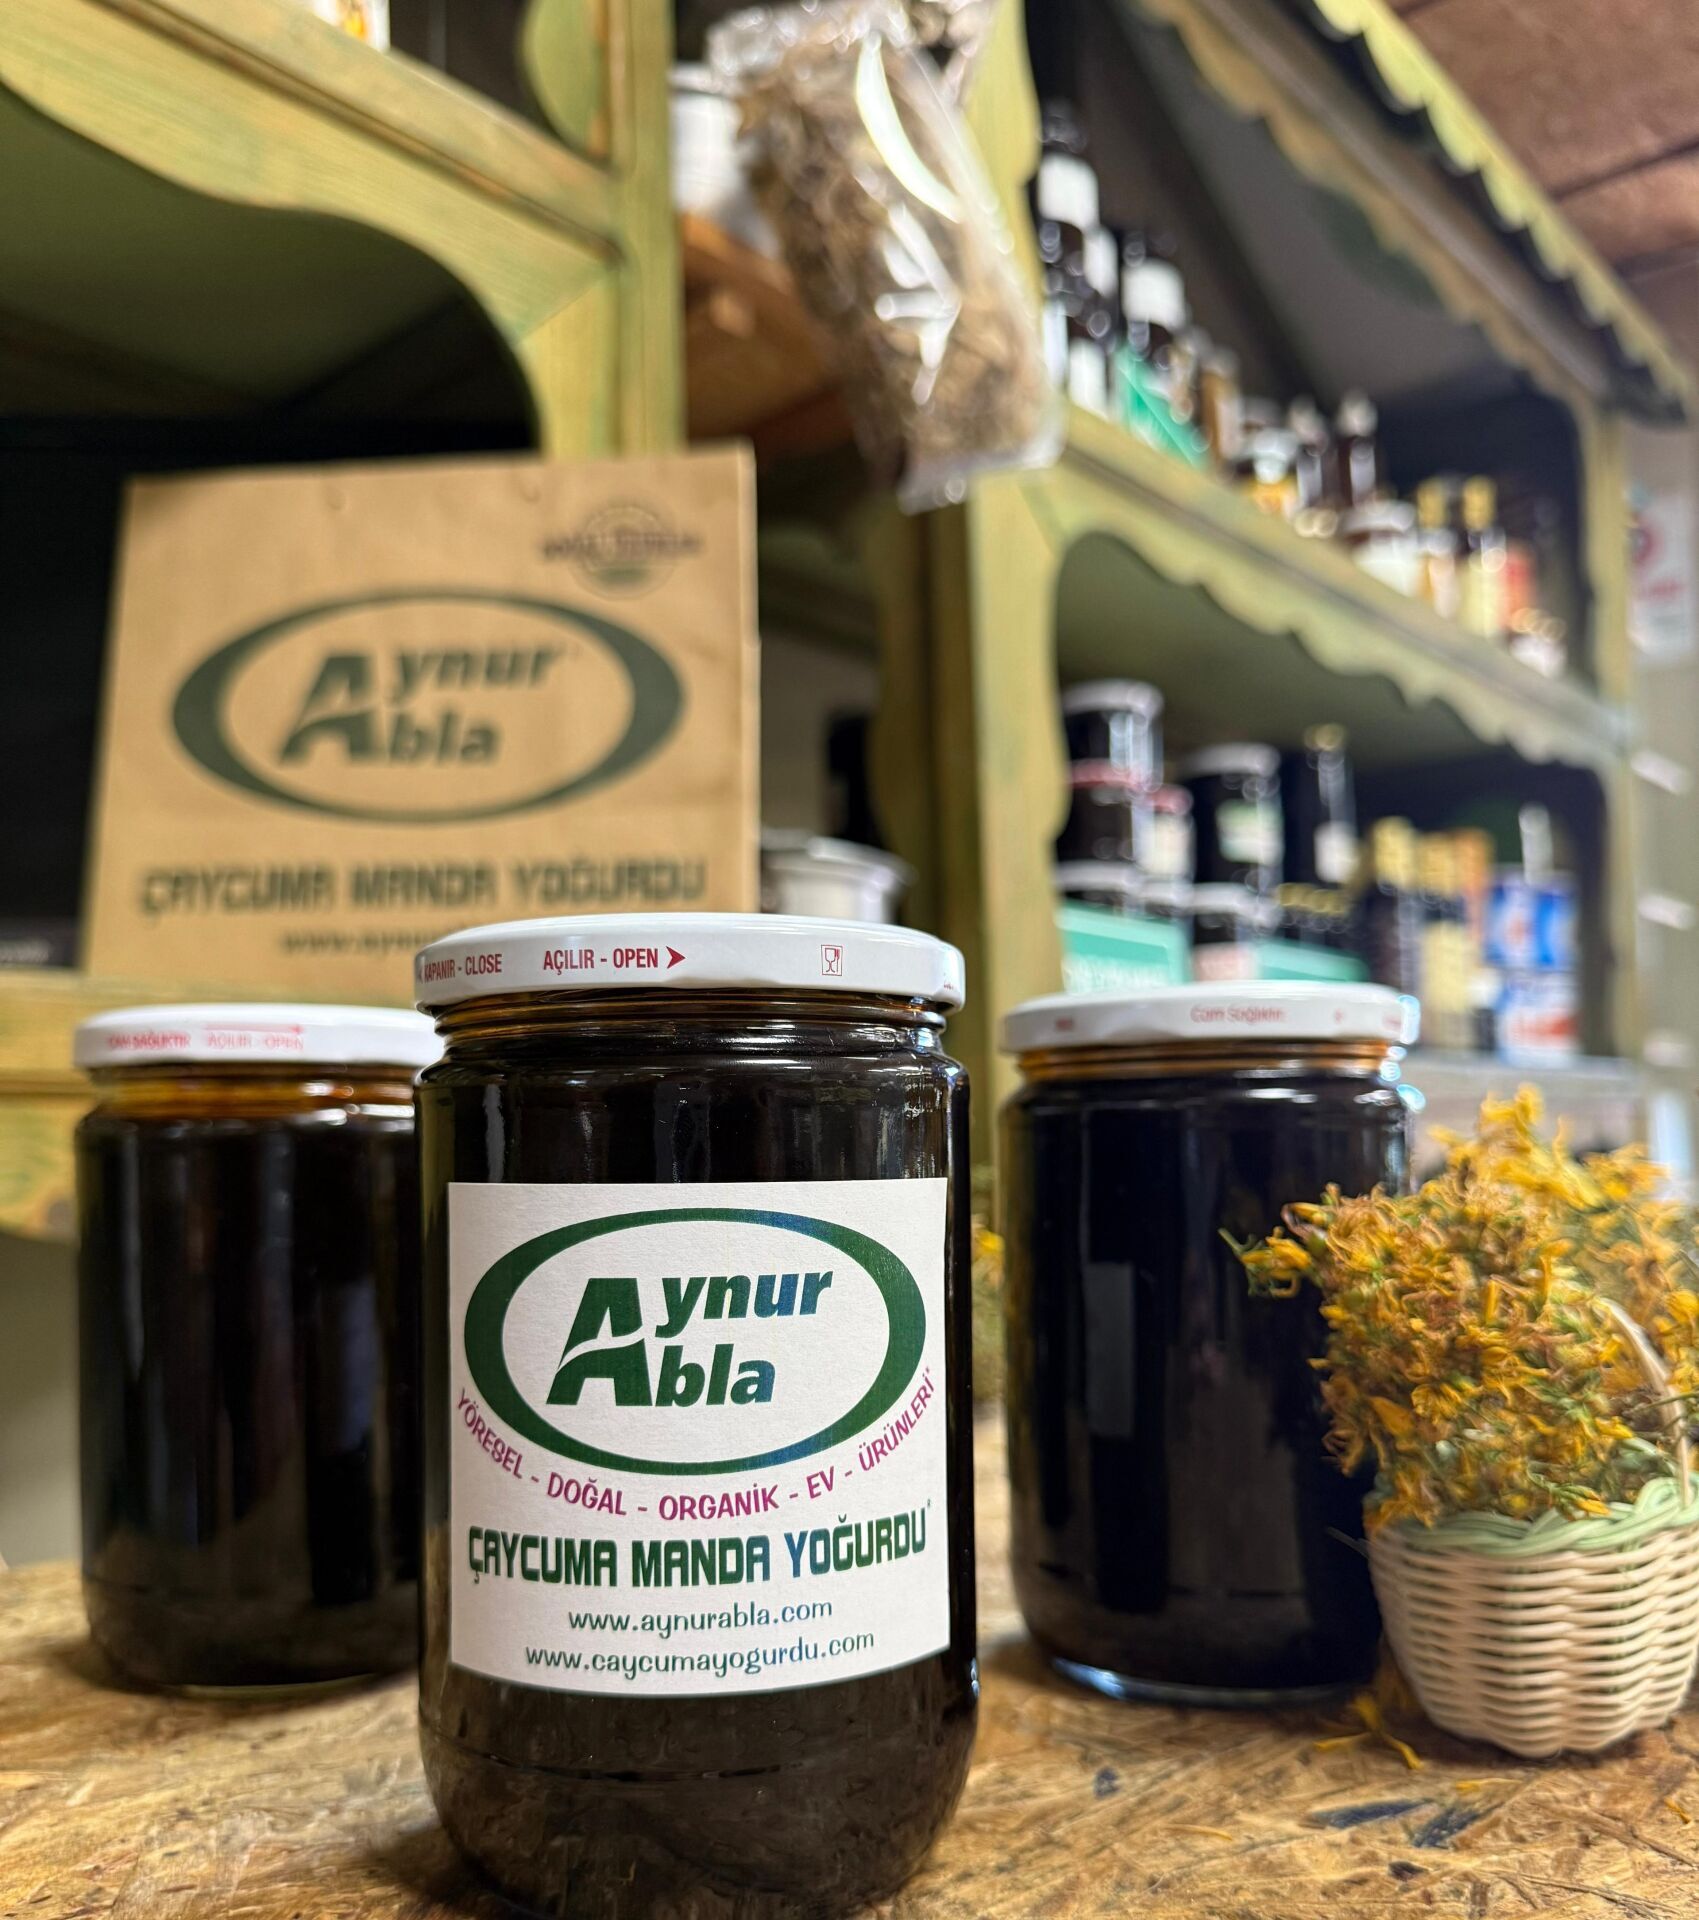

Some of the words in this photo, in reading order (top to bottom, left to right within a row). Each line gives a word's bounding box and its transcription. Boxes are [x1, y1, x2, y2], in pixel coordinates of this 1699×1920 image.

[301, 644, 564, 707] Aynur
[278, 709, 501, 768] Abla
[351, 862, 498, 909] MANDA
[424, 959, 455, 982] KAPANIR
[465, 954, 502, 976] CLOSE
[543, 949, 594, 975] AÇILIR
[612, 947, 659, 970] OPEN
[557, 1270, 834, 1345] Aynur
[545, 1338, 776, 1408] Abla
[456, 1387, 523, 1480] YÖRESEL
[546, 1477, 627, 1517] DOĞAL
[658, 1483, 780, 1521] ORGANİK
[806, 1466, 836, 1500] EV
[467, 1525, 618, 1586] ÇAYCUMA
[631, 1535, 771, 1588] MANDA
[784, 1507, 927, 1578] YOĞURDU
[568, 1600, 833, 1640] www.aynurabla.com
[525, 1631, 875, 1681] www.caycumayogurdu.com
